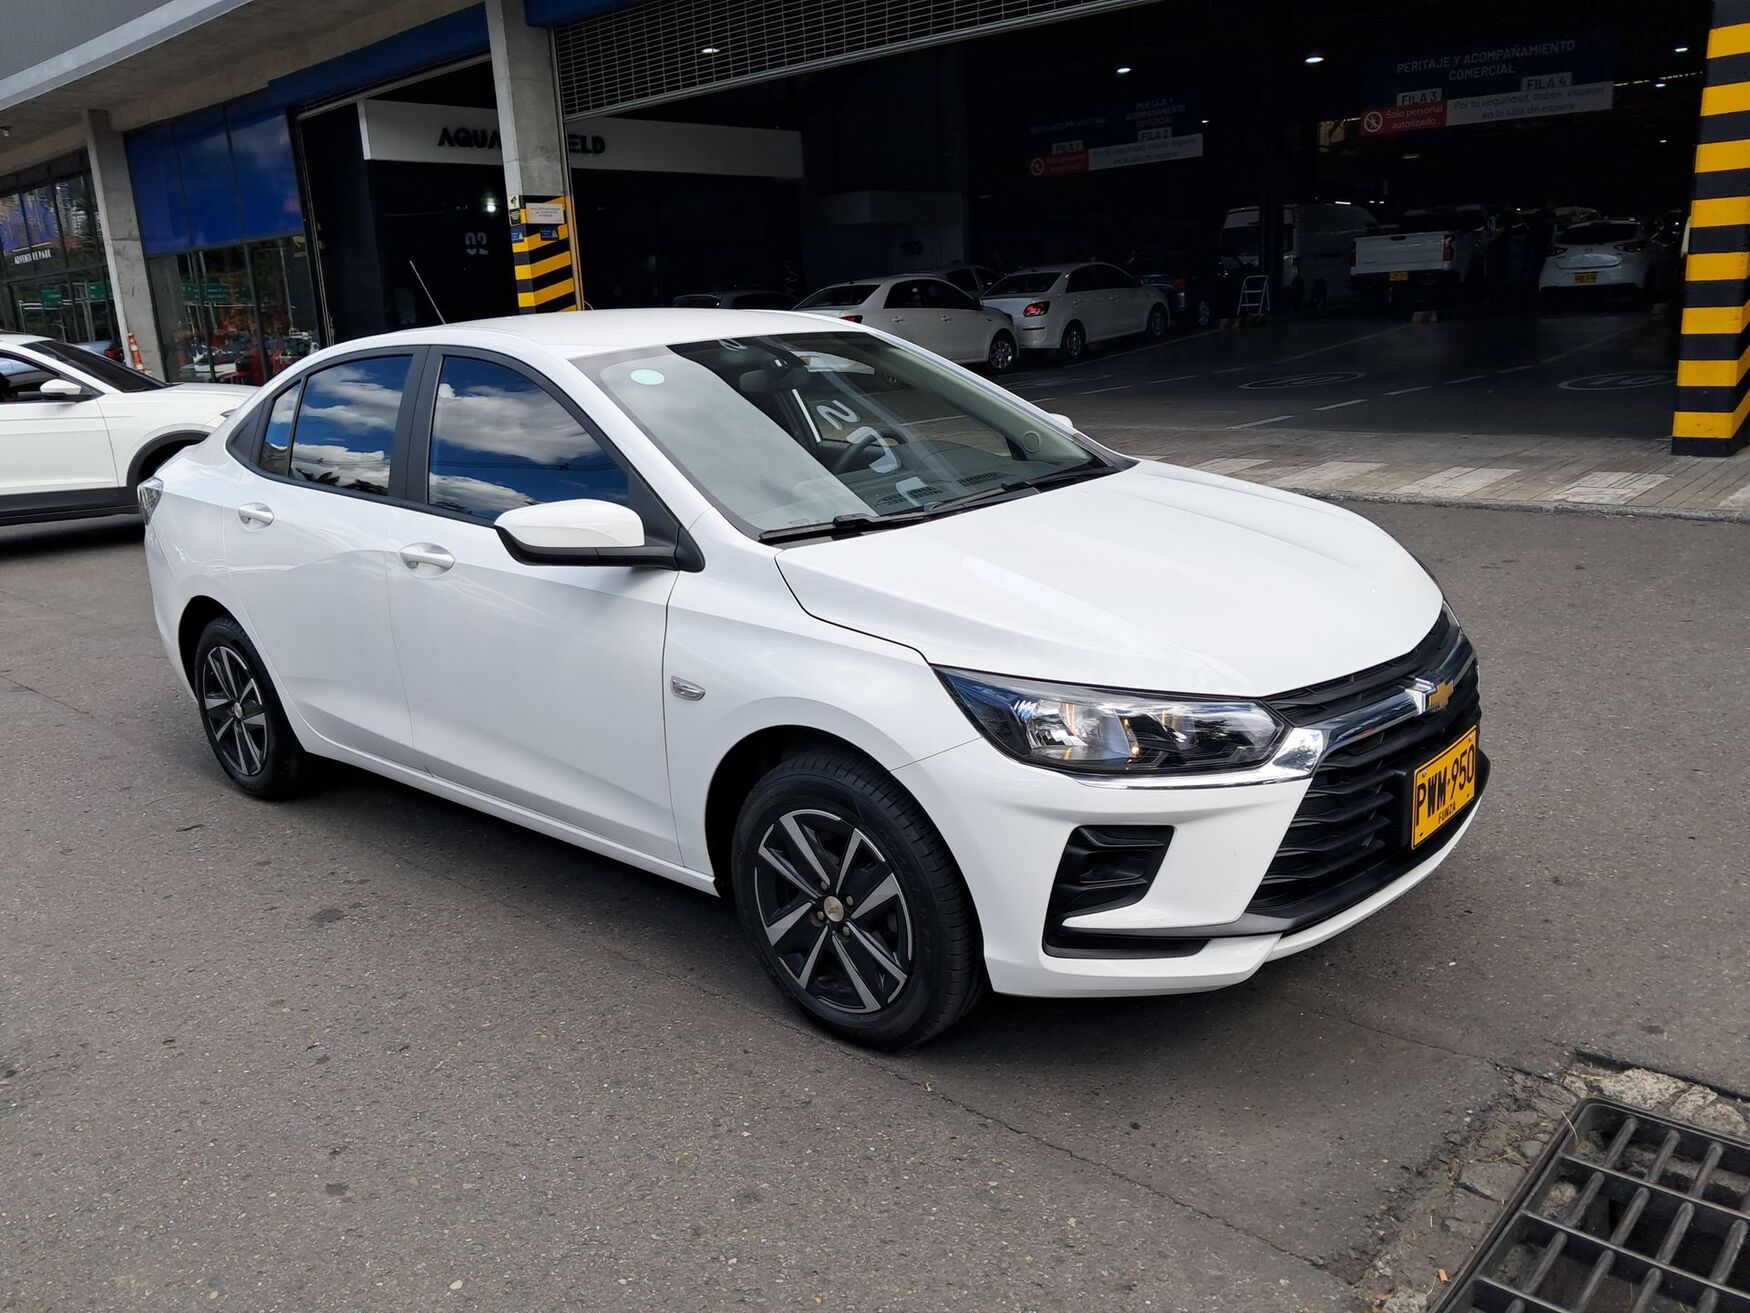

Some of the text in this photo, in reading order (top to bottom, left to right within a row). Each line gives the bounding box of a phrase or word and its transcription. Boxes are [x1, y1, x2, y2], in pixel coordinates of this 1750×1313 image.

[1396, 39, 1576, 74] PERITAJE Y ACOMPAÑAMIENTO
[1448, 63, 1516, 81] COMERCIAL
[1526, 77, 1567, 92] FILA 4
[1401, 91, 1438, 106] FILA 3
[568, 134, 606, 154] ELD
[464, 231, 489, 255] 02
[1438, 801, 1456, 824] FUNZA
